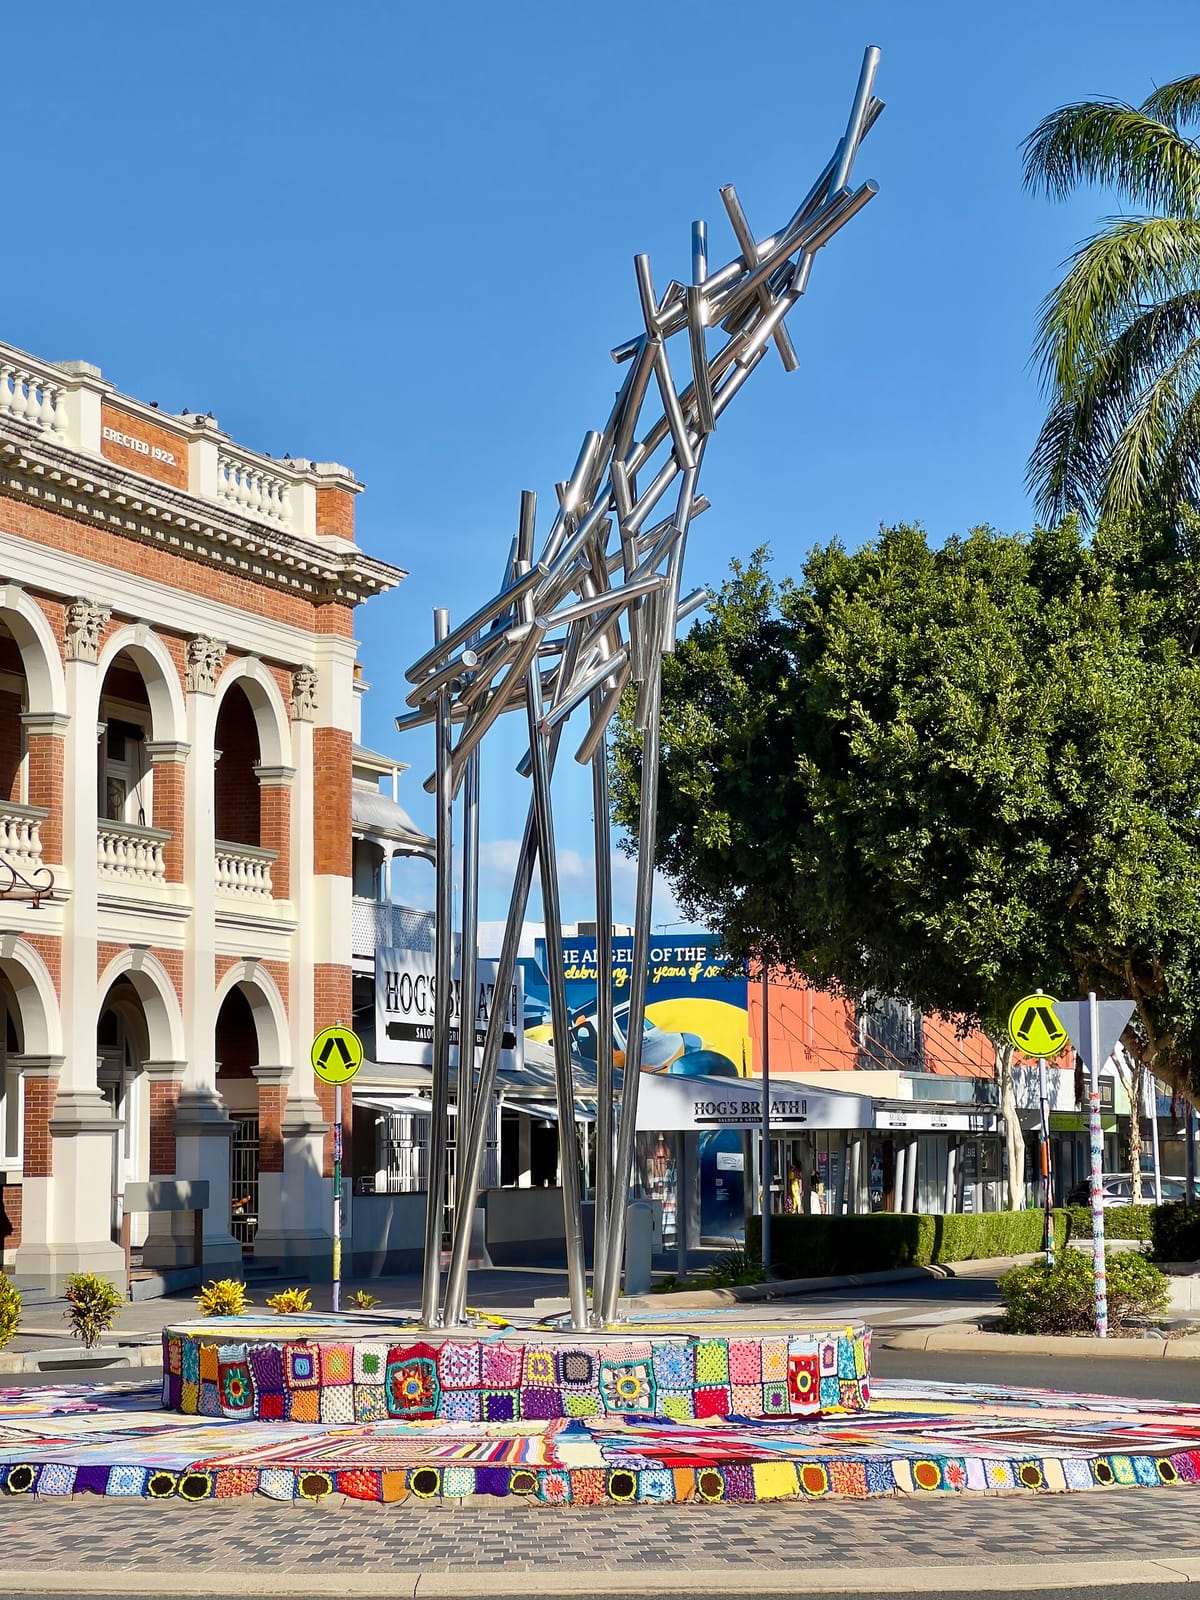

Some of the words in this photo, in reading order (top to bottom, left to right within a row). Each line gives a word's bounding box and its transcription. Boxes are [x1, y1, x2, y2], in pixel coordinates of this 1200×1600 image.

[103, 426, 149, 455] ERECTED
[562, 949, 580, 963] HE
[650, 948, 672, 962] OF
[674, 947, 707, 961] THE
[652, 966, 687, 984] years
[688, 962, 704, 982] of
[694, 1101, 738, 1115] HOG'S
[740, 1100, 799, 1115] BRATH
